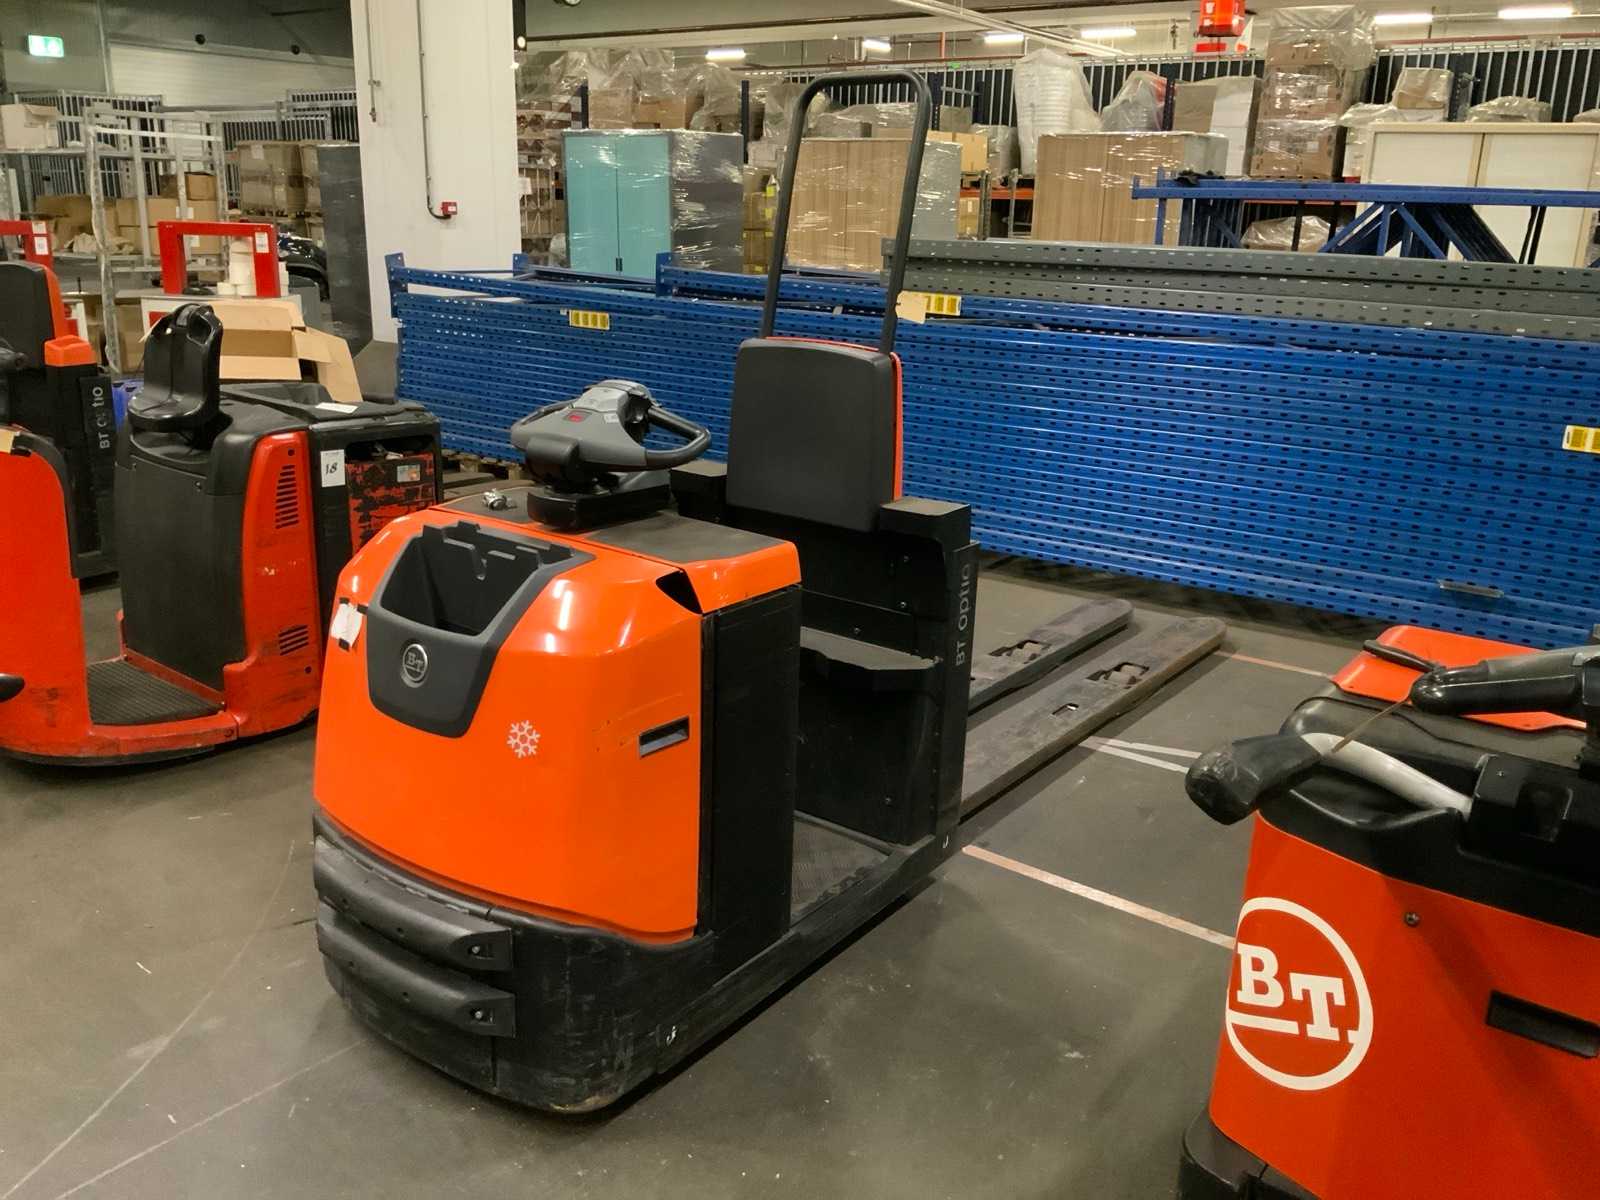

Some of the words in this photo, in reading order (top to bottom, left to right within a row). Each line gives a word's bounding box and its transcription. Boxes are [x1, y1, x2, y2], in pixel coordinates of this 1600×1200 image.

[91, 386, 108, 428] otio
[98, 431, 111, 449] BT
[325, 461, 338, 475] 18
[958, 563, 971, 632] optio
[407, 651, 424, 673] BT
[955, 640, 967, 667] BT
